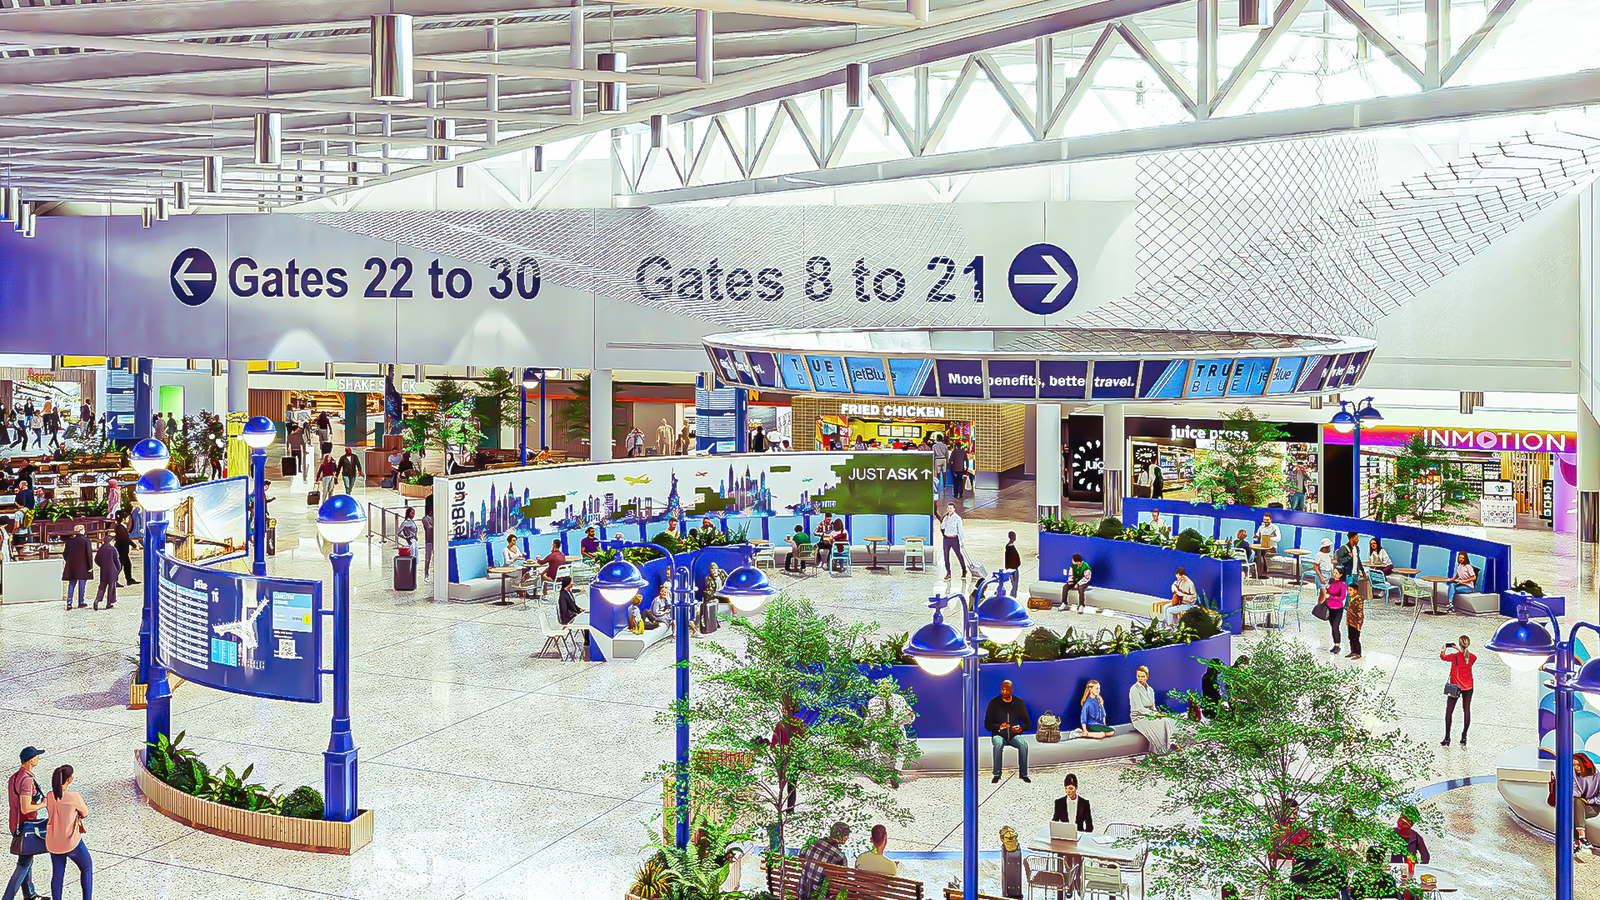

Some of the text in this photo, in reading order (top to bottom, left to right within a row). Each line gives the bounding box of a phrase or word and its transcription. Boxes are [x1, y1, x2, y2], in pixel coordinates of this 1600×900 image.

[229, 257, 541, 300] Gates 22 to 30
[635, 255, 984, 302] Gates 8 to 21
[791, 358, 834, 373] TUE
[1197, 363, 1245, 378] TRUE
[797, 373, 838, 388] BUE
[948, 373, 982, 385] More
[1049, 375, 1087, 387] bette
[1094, 376, 1135, 388] travel.
[1257, 366, 1292, 385] jeBlue
[338, 379, 417, 393] SHAKE SCK
[1191, 381, 1240, 393] BLUE
[840, 403, 945, 418] FRIED CHICKEN
[1171, 425, 1206, 441] juice
[848, 468, 918, 480] JUST ASK
